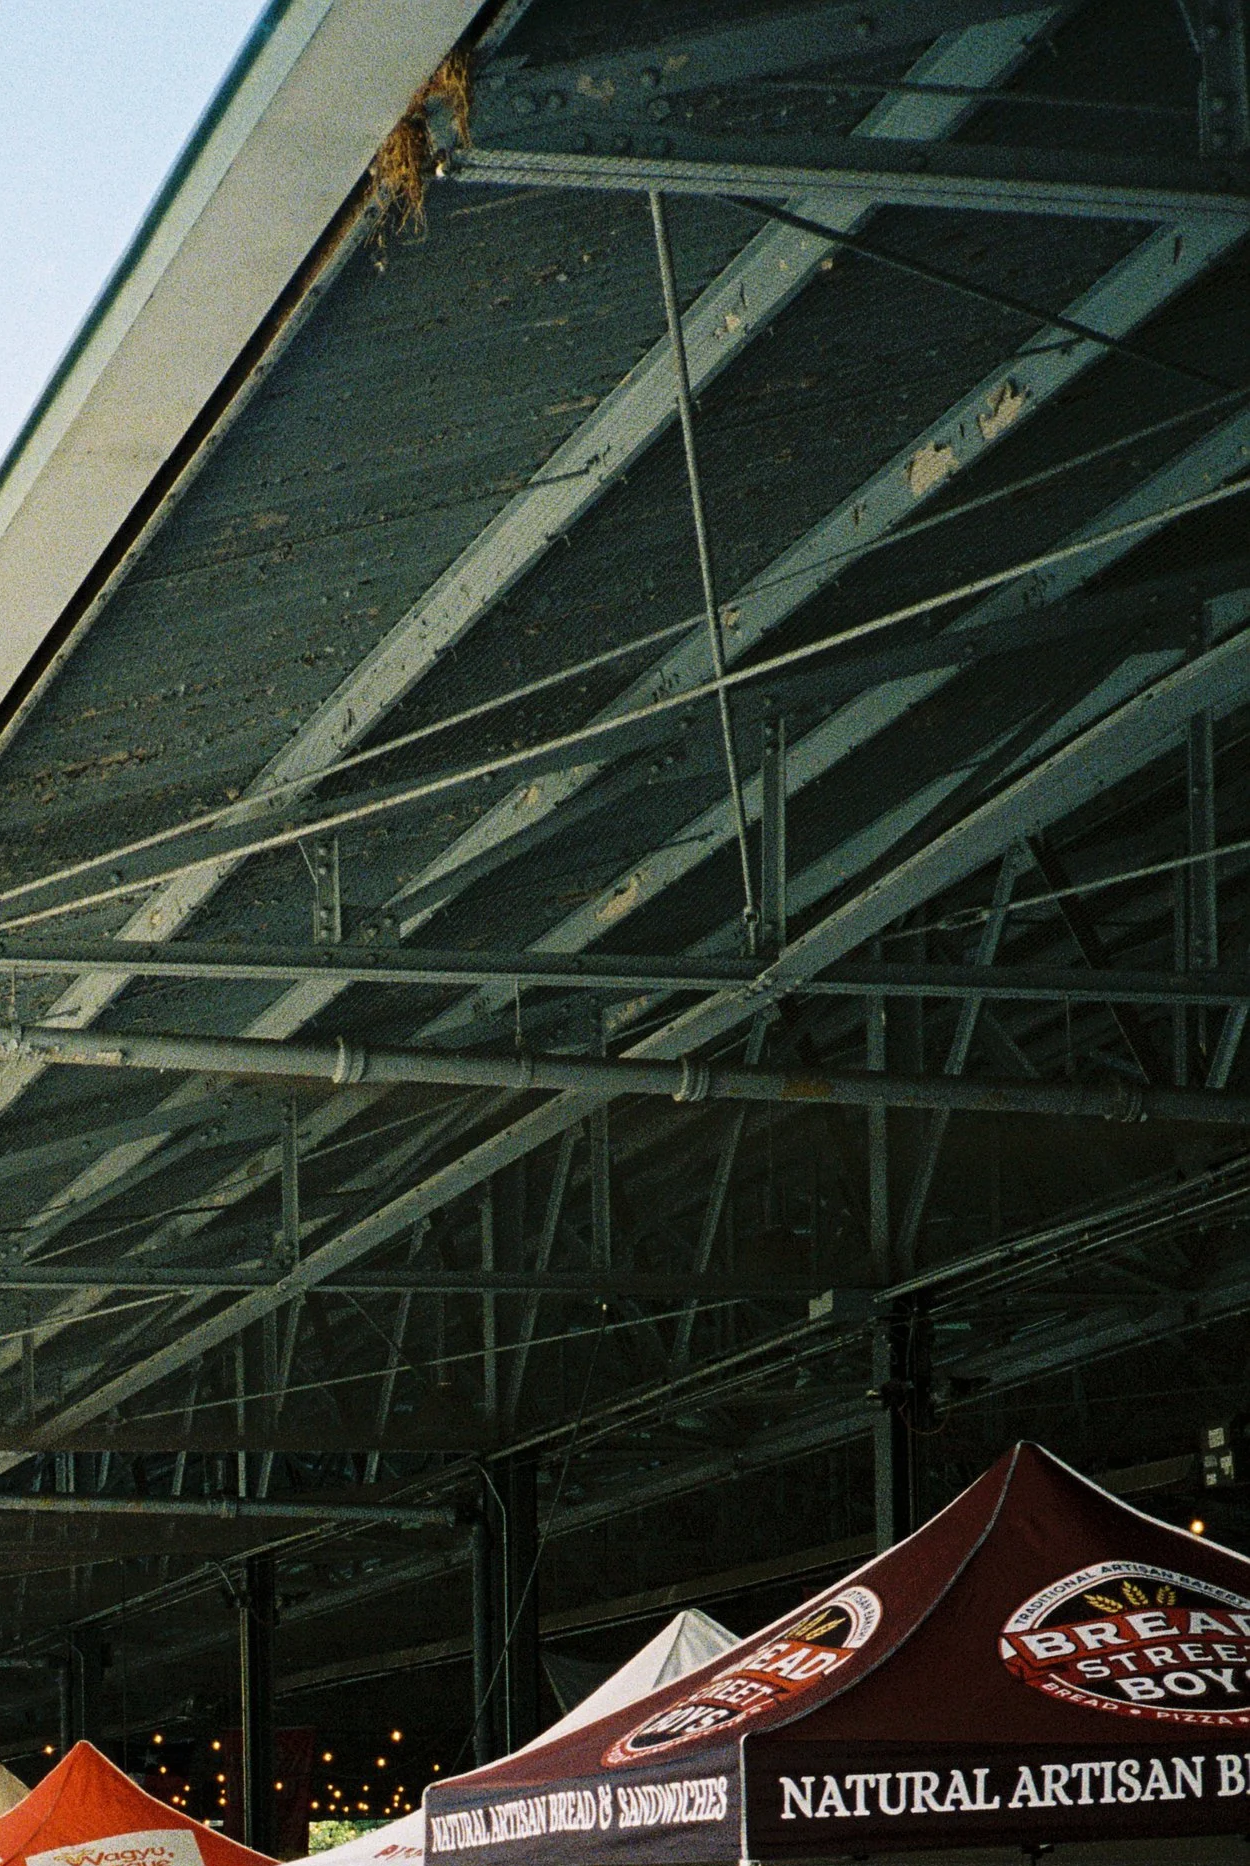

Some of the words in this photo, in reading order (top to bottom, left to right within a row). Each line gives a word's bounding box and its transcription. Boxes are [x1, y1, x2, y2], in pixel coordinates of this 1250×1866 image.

[1014, 1571, 1097, 1625] TRADITIONAL
[1099, 1562, 1174, 1580] ARTISAN
[1179, 1575, 1249, 1606] BAKERY
[1076, 1642, 1250, 1679] STREE
[1114, 1667, 1250, 1700] BOY
[1041, 1682, 1119, 1711] BREAD
[1155, 1710, 1234, 1726] PIZZA
[779, 1767, 1000, 1819] NATURAL
[1007, 1756, 1205, 1809] ARTISAN
[1215, 1752, 1250, 1797] B
[430, 1808, 491, 1852] NATURAL
[489, 1795, 550, 1841] ARTISAN
[548, 1790, 597, 1832] BREAD
[597, 1784, 613, 1830] &
[616, 1776, 728, 1829] SANDWICHES
